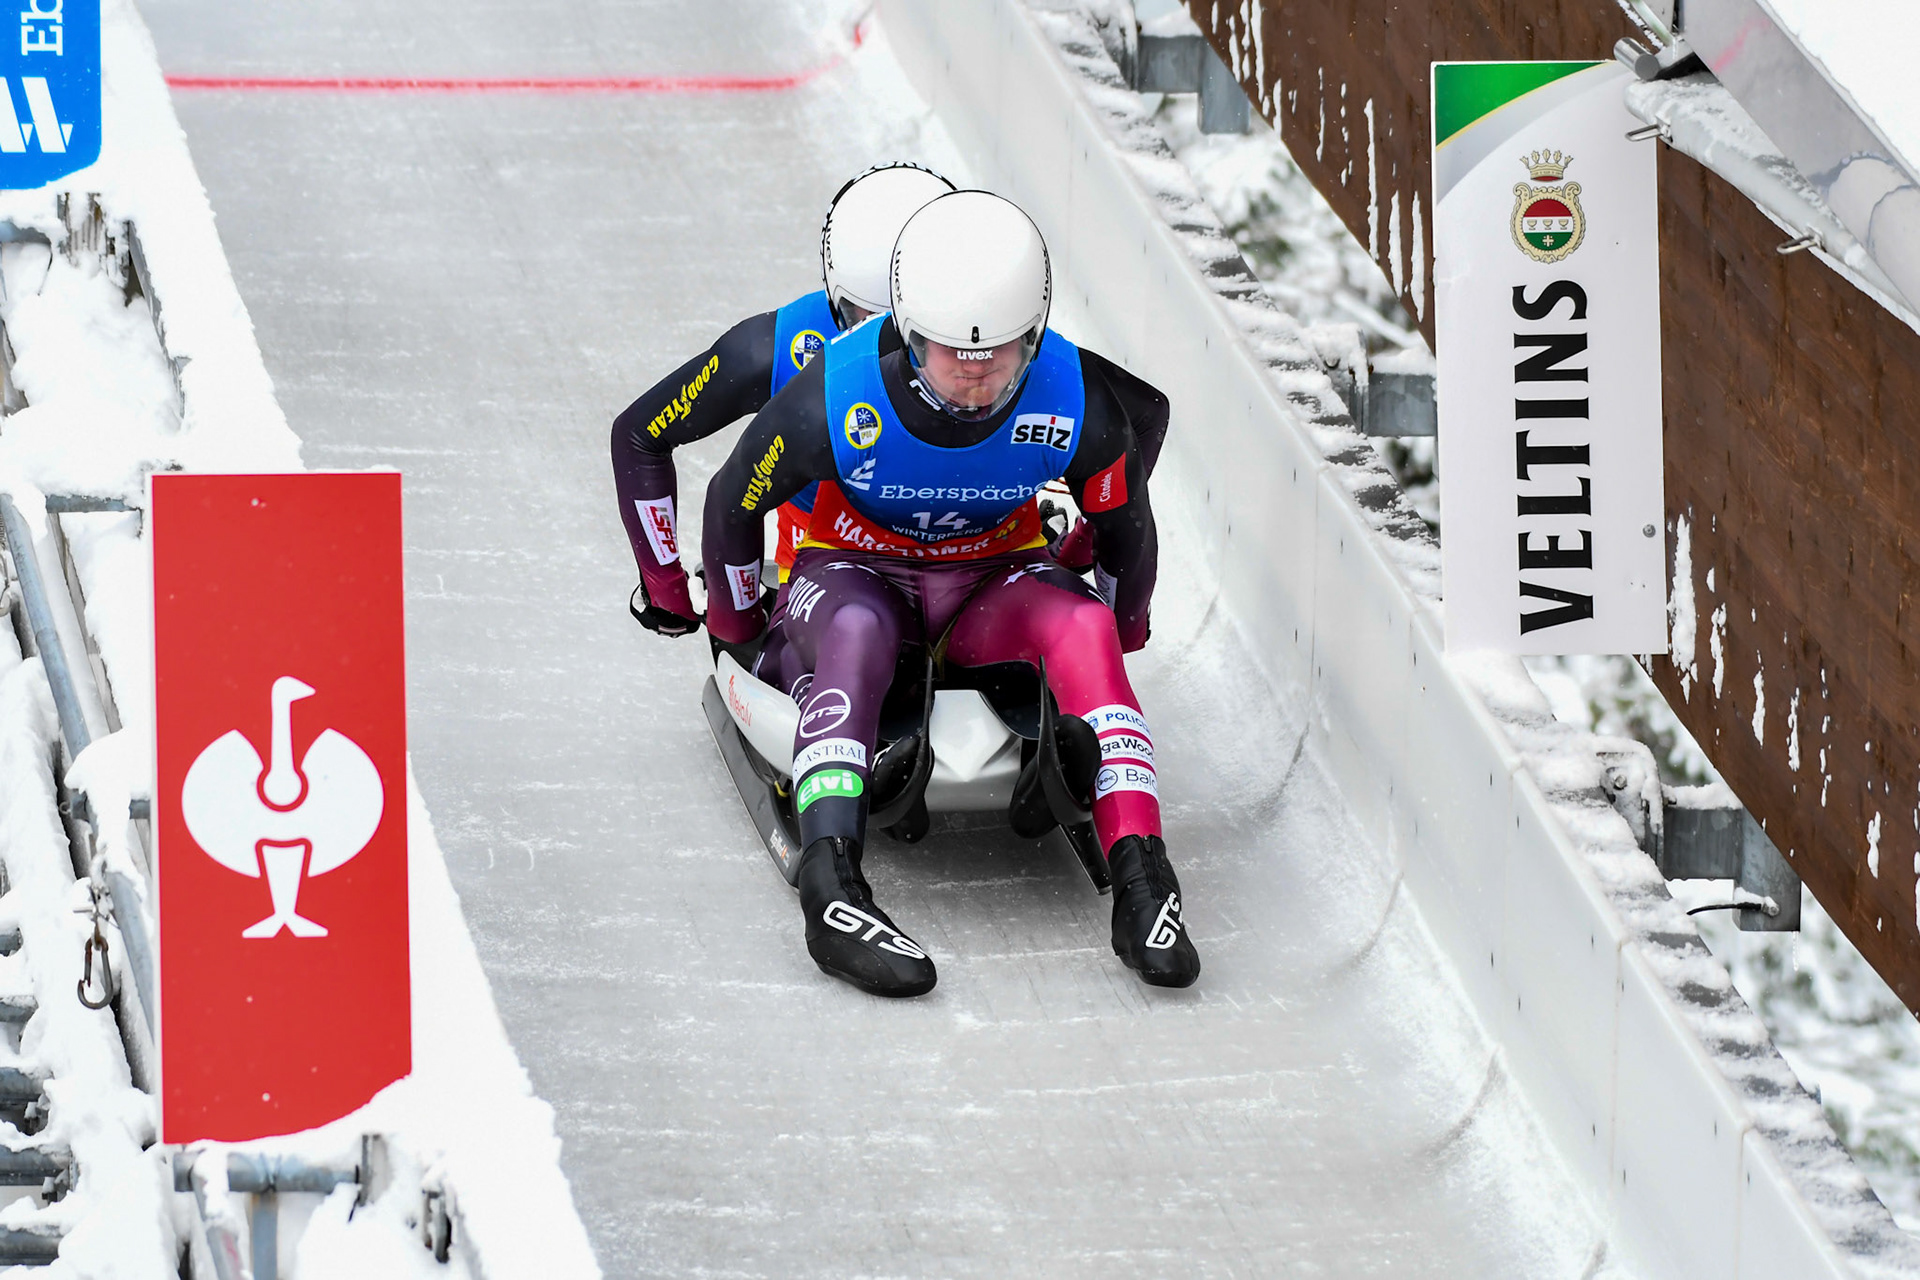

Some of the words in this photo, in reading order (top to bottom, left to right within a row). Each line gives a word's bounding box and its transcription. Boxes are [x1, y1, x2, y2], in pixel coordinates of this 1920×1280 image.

[956, 350, 993, 360] uvex
[647, 355, 719, 438] GOODYEAR
[1013, 416, 1071, 450] SEIZ
[741, 435, 785, 510] GOODYEAR
[1512, 279, 1594, 636] VELTINS
[649, 505, 677, 554] LSFP
[892, 525, 983, 541] WINTERBERG
[912, 512, 970, 530] 14
[739, 568, 756, 600] LSFP
[804, 744, 865, 764] ASTRAL
[823, 901, 926, 960] GTS
